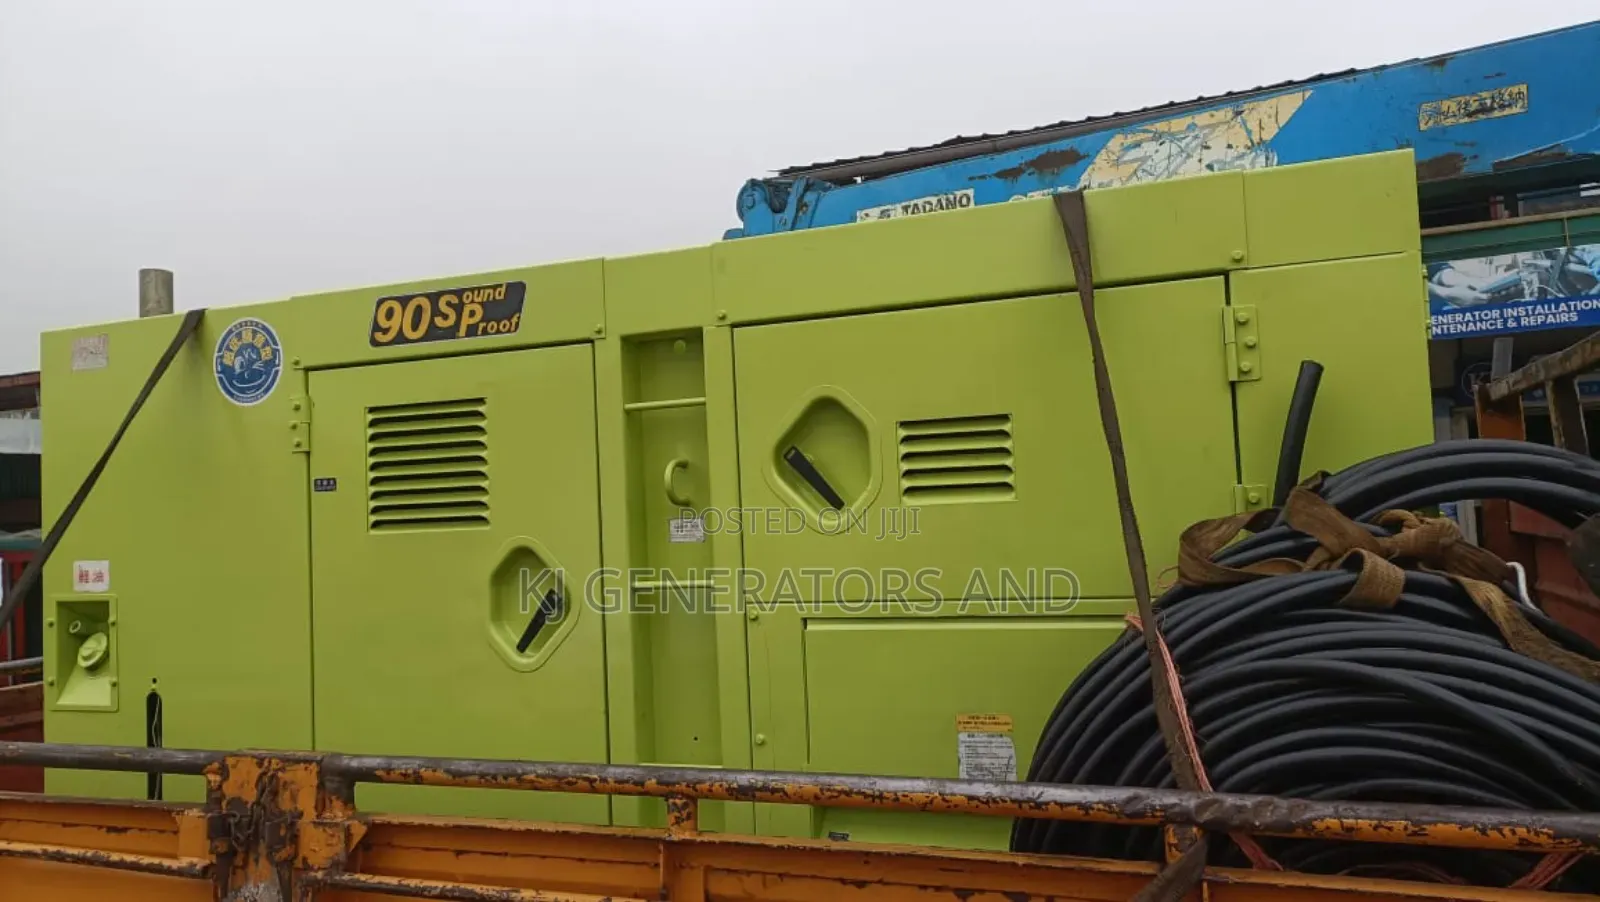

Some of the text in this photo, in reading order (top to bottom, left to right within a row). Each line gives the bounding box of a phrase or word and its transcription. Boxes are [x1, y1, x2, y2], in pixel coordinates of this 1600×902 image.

[900, 193, 971, 216] TADANO
[374, 296, 432, 343] 90
[1431, 309, 1500, 325] ENERATOR
[1432, 312, 1578, 335] NTENANCE & REPAIRS
